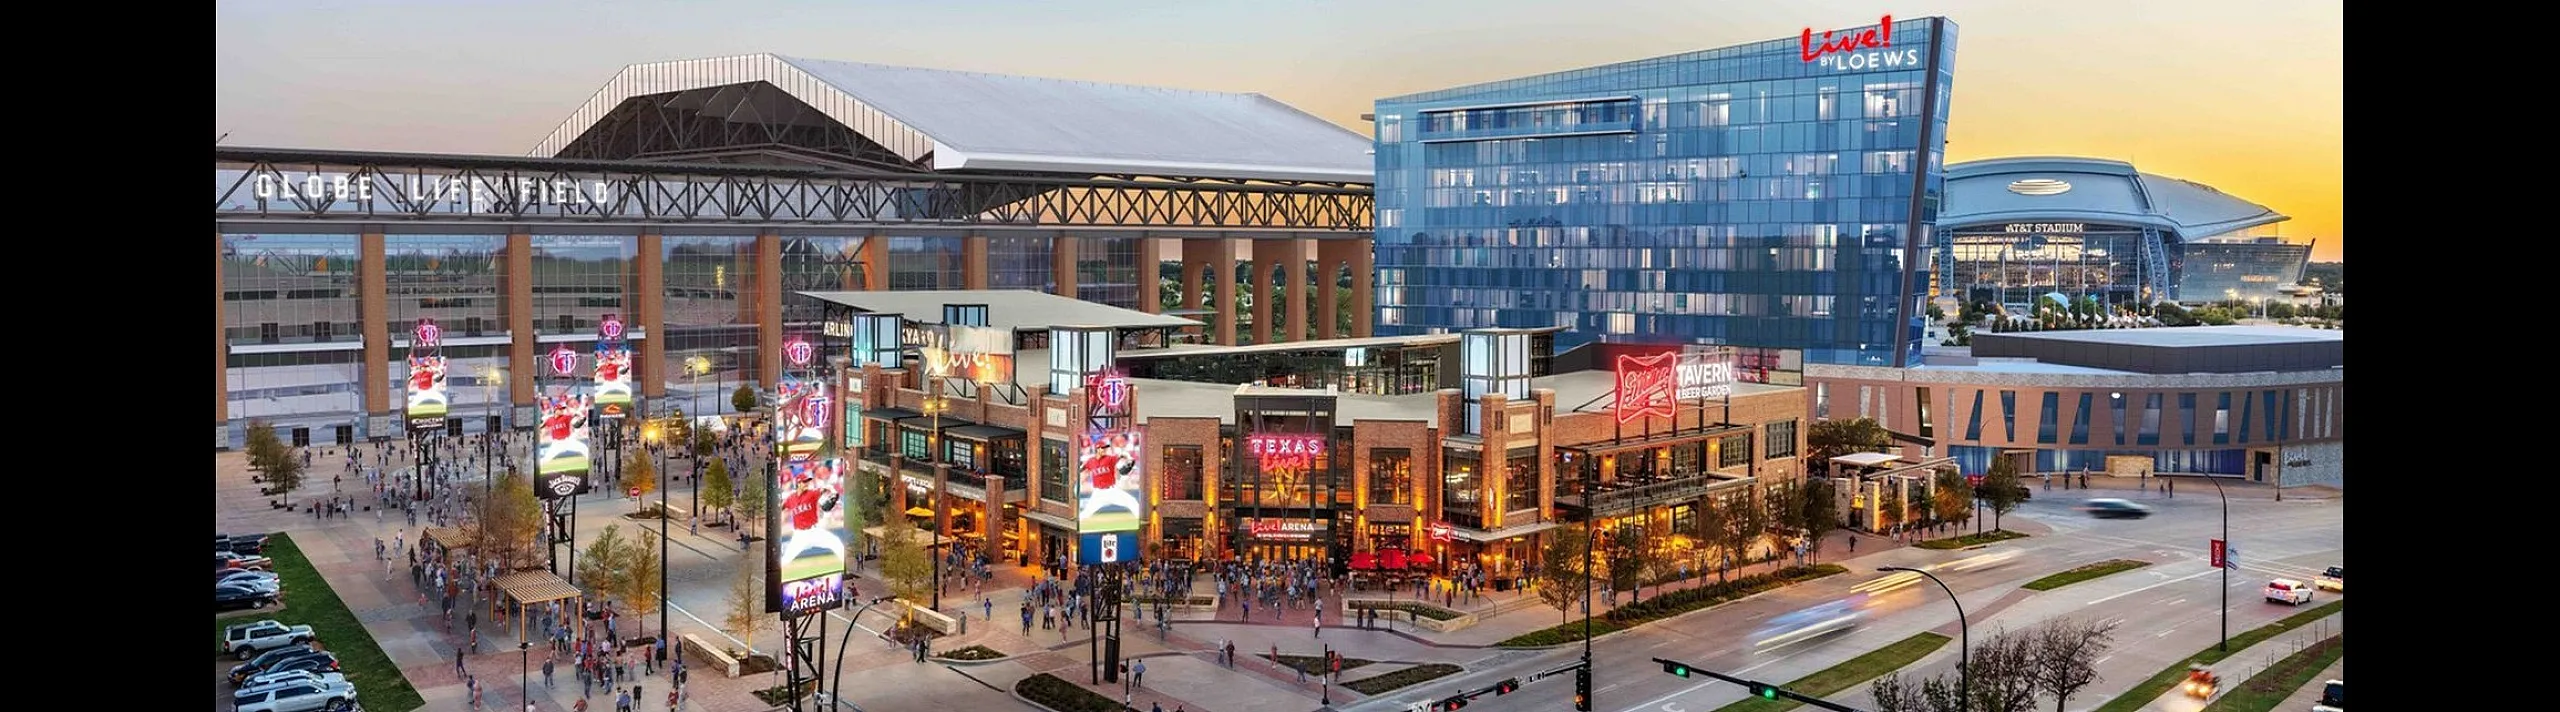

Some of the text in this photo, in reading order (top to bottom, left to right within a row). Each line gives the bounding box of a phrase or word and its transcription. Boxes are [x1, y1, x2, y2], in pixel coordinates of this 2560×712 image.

[1800, 14, 1892, 63] Live!
[1819, 49, 1918, 71] BY LOEWS
[257, 173, 608, 204] GLOBE LIFE FIELD
[2005, 223, 2084, 233] AT&T STADIUM
[1676, 361, 1732, 388] TAVERN
[1682, 387, 1701, 399] BEER
[1701, 384, 1731, 397] GARDEN
[1251, 438, 1321, 455] TEXAS
[1281, 522, 1315, 532] ARENA
[790, 592, 836, 612] ARENA
